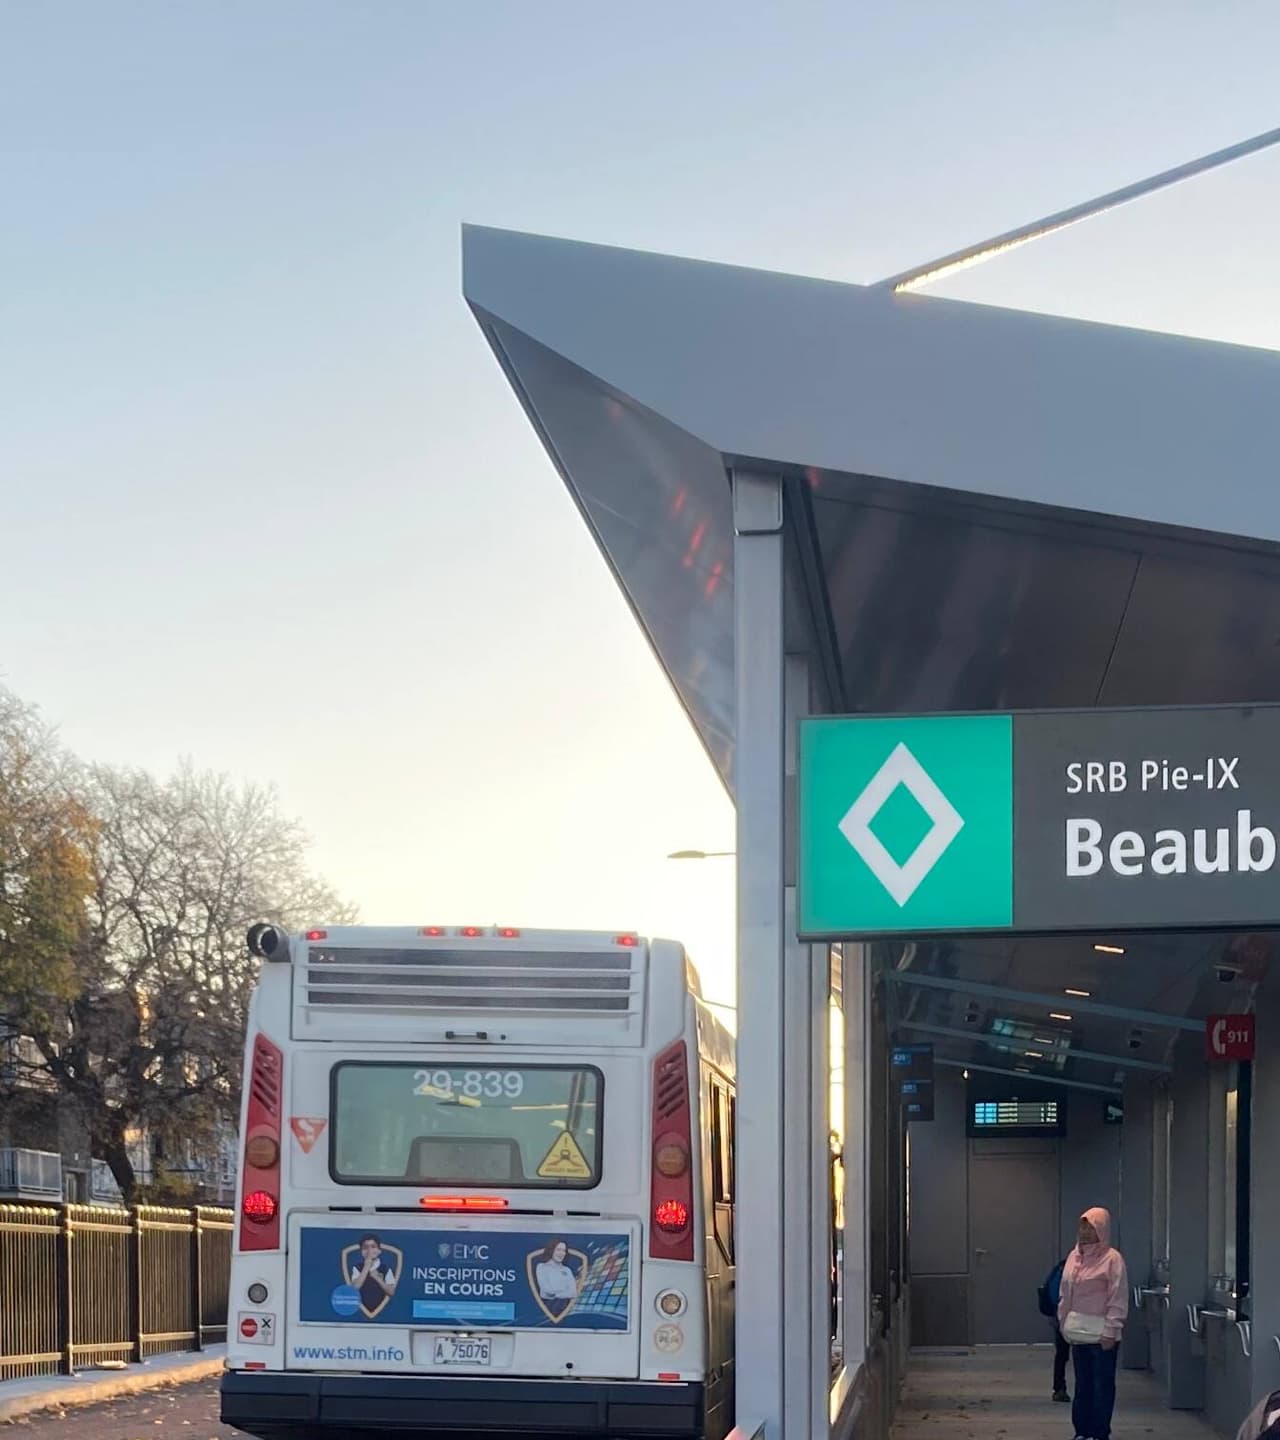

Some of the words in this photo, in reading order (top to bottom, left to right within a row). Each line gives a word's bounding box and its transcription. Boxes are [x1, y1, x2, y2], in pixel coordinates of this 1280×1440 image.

[1066, 761, 1127, 794] SRB
[1141, 757, 1240, 792] Pie-IX
[1227, 1031, 1249, 1043] 911
[413, 1069, 524, 1098] 29-839
[453, 1243, 489, 1260] EMC
[412, 1266, 516, 1282] INSCRIPTIONS
[424, 1282, 446, 1295] EN
[449, 1282, 504, 1297] COURS
[294, 1345, 404, 1361] www.stm.info
[436, 1343, 444, 1358] A
[451, 1343, 489, 1359] 75076
